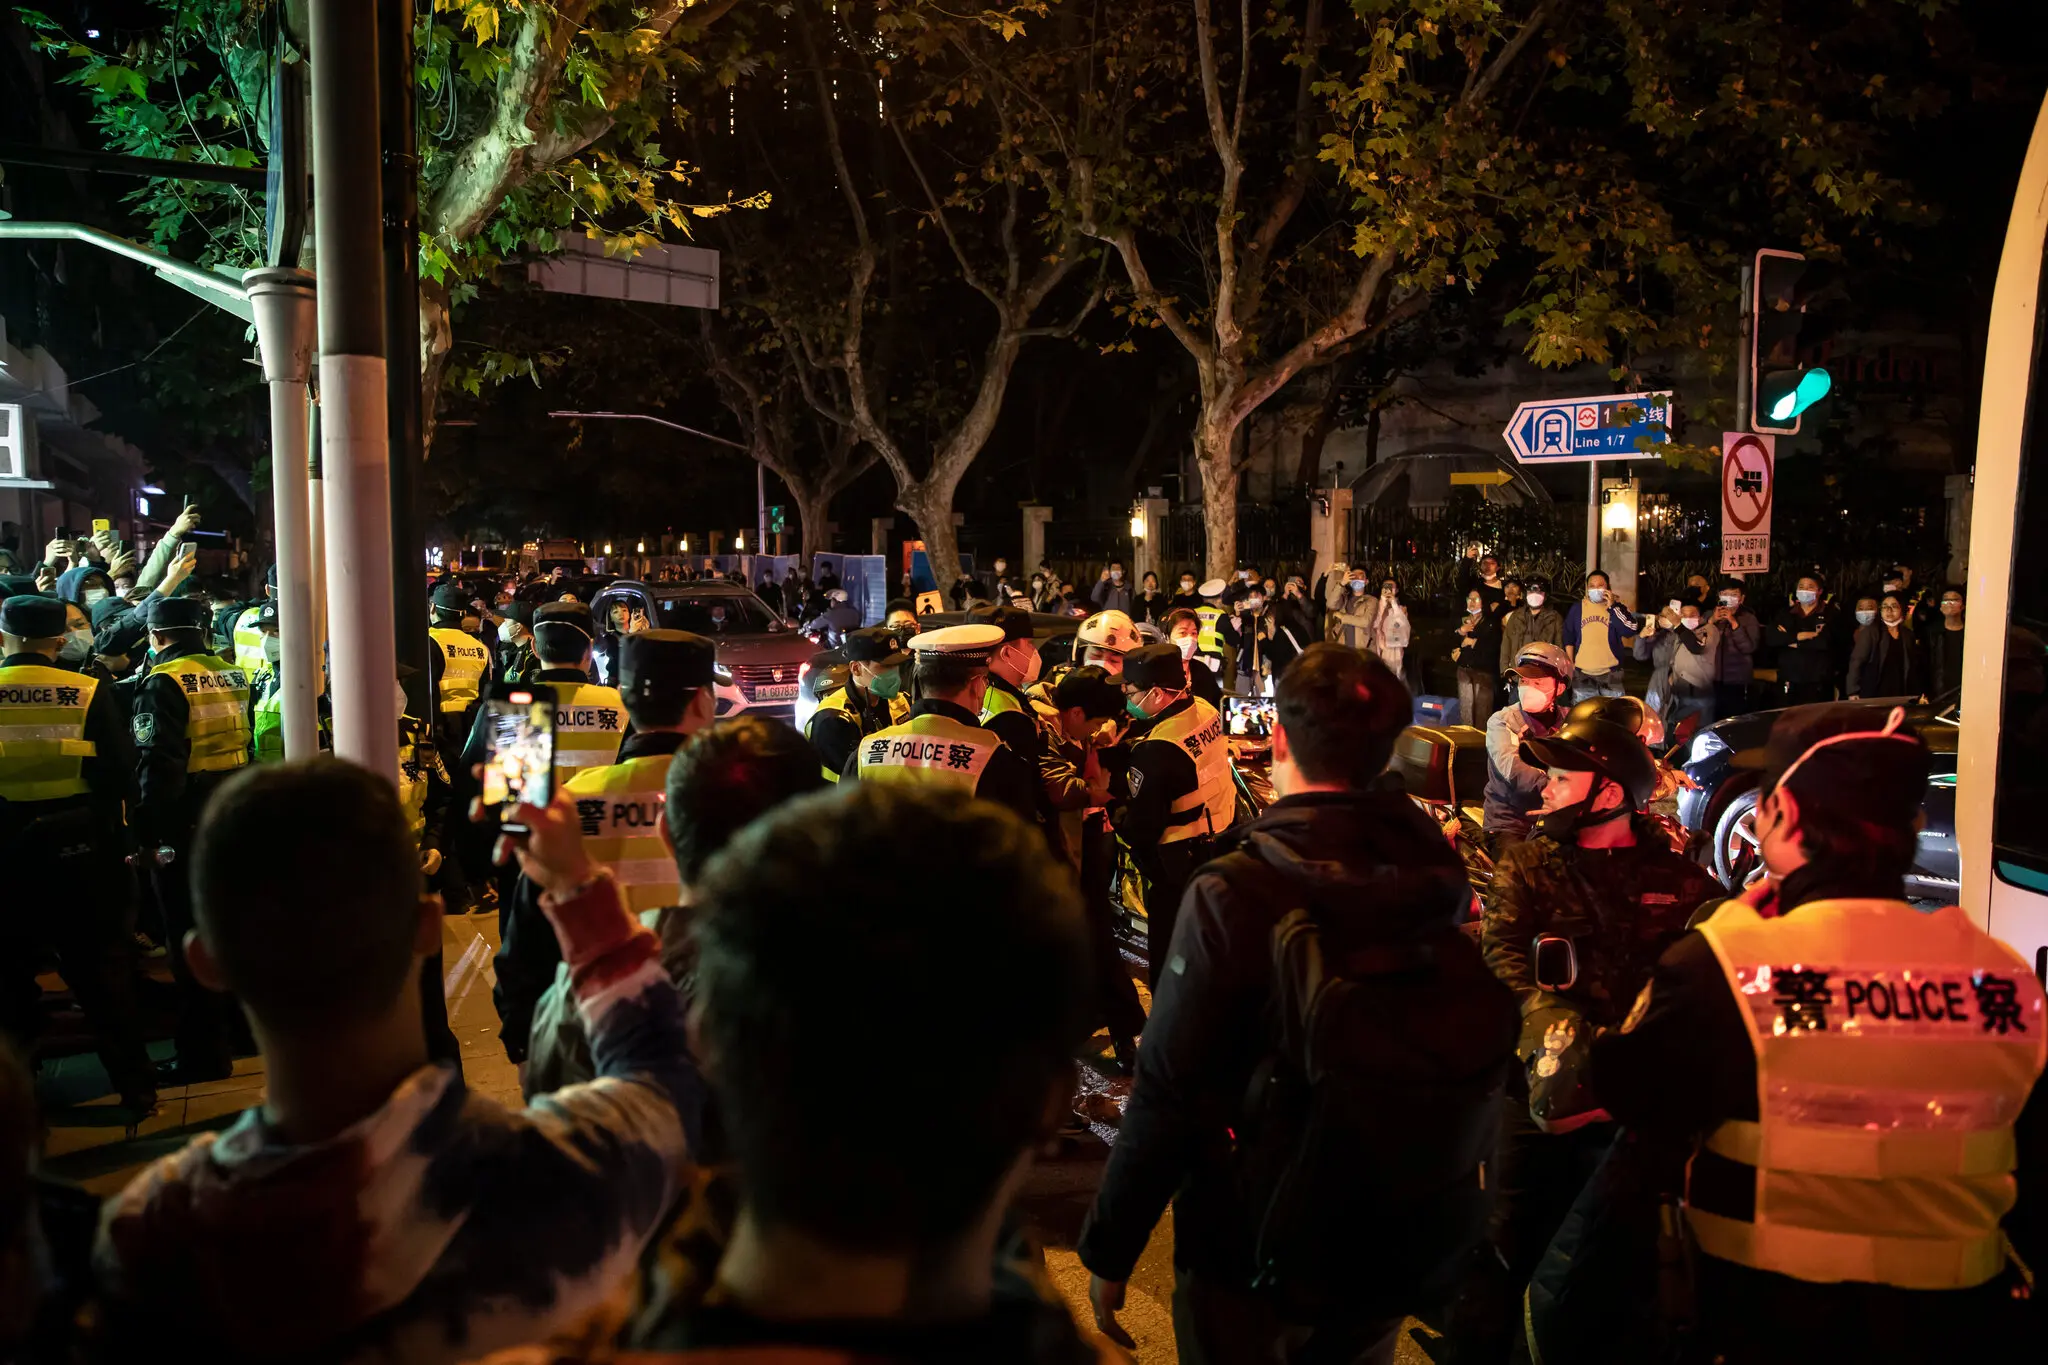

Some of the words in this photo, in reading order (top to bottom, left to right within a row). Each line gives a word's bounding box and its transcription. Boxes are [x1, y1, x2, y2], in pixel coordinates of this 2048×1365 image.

[1575, 437, 1600, 448] Line
[1606, 434, 1626, 447] 1/7
[457, 647, 476, 657] POLICE
[180, 674, 198, 693] 警
[200, 674, 232, 689] POLICE
[230, 671, 247, 688] 察
[0, 689, 52, 704] POLICE
[56, 687, 80, 706] 察
[555, 711, 594, 726] OLICE
[597, 708, 618, 730] 察
[868, 739, 891, 764] 警
[892, 741, 944, 762] POLICE
[947, 744, 975, 770] 察
[1184, 734, 1203, 759] 警
[576, 800, 606, 836] 警
[612, 802, 659, 828] POLI
[1773, 968, 1833, 1032] 警
[1845, 980, 1969, 1022] POLICE
[1970, 973, 2026, 1034] 察
